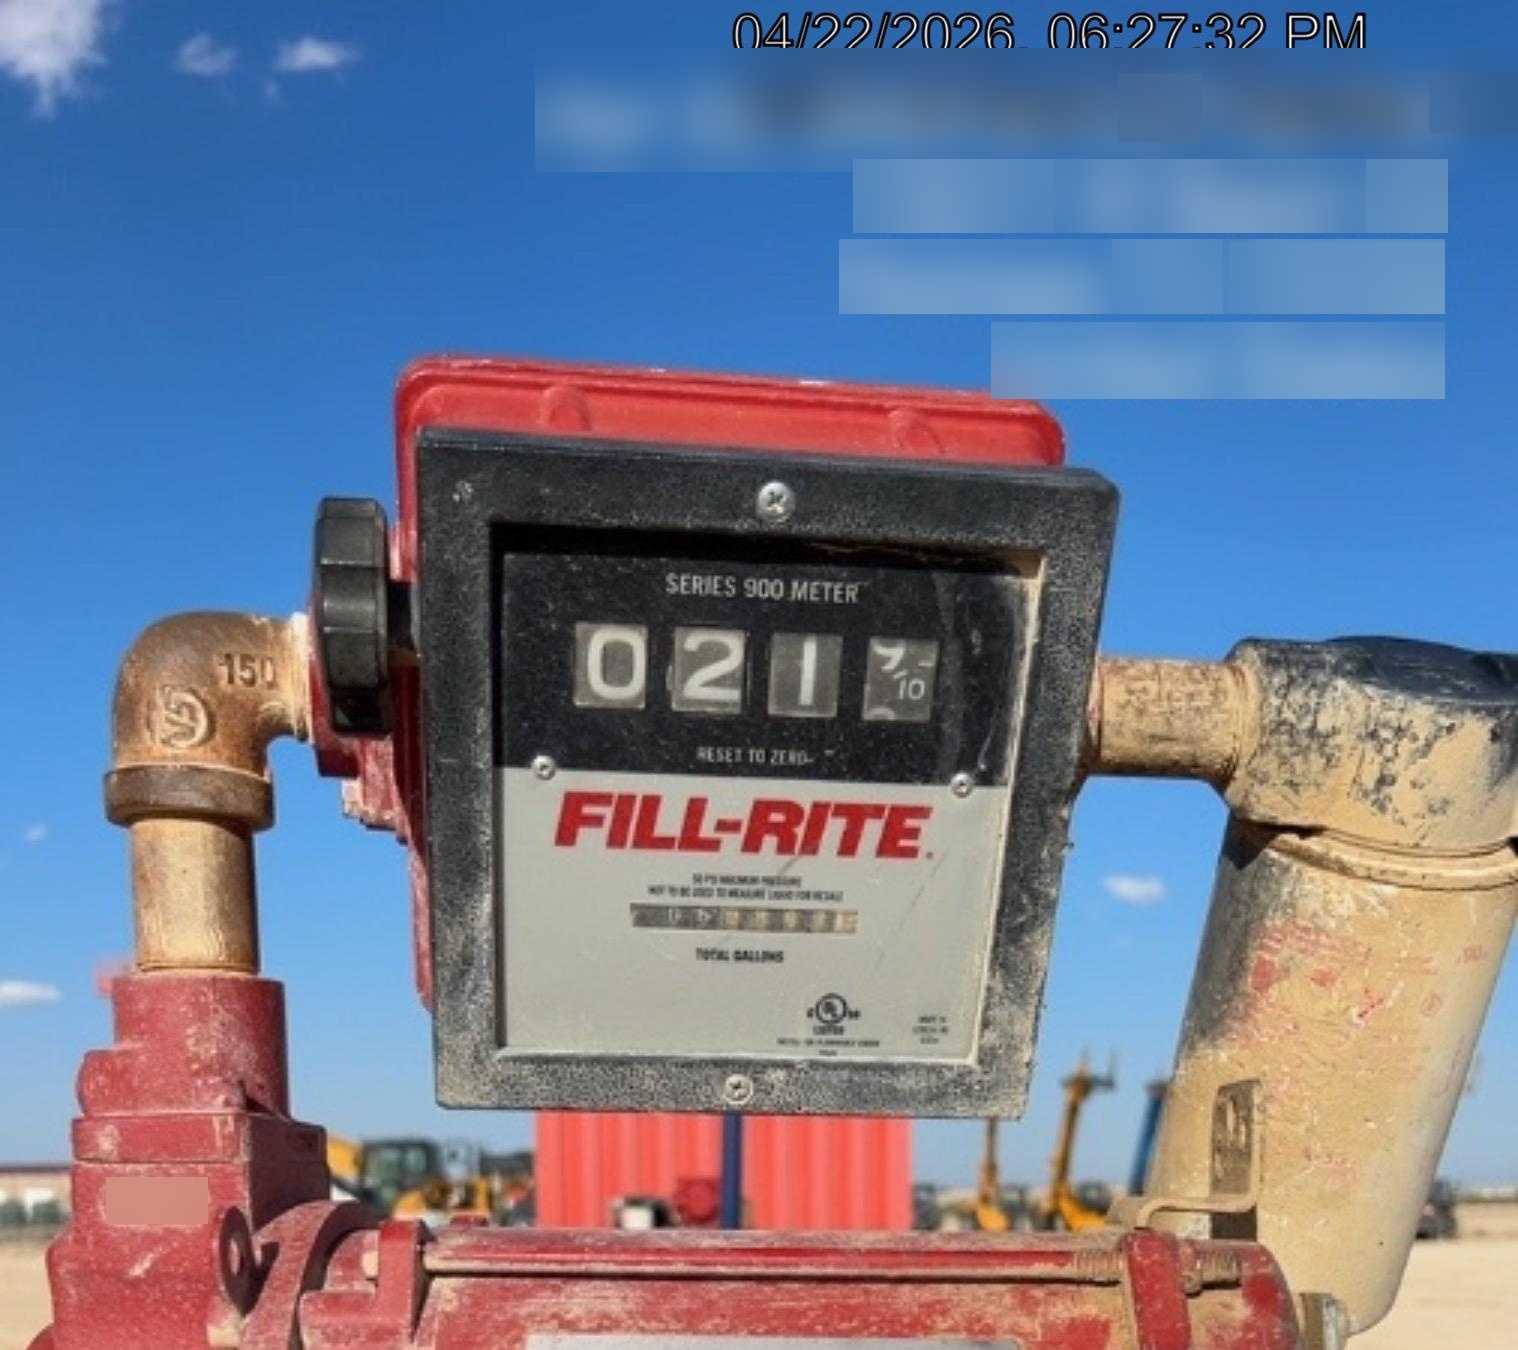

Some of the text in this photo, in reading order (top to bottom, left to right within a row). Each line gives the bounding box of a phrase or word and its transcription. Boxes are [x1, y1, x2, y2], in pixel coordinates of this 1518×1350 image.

[665, 573, 860, 604] SERIES 900 METER
[218, 653, 277, 689] 150
[750, 748, 766, 764] TO
[553, 791, 934, 859] FILL-RITE
[696, 948, 784, 963] TOTAL GALLONS
